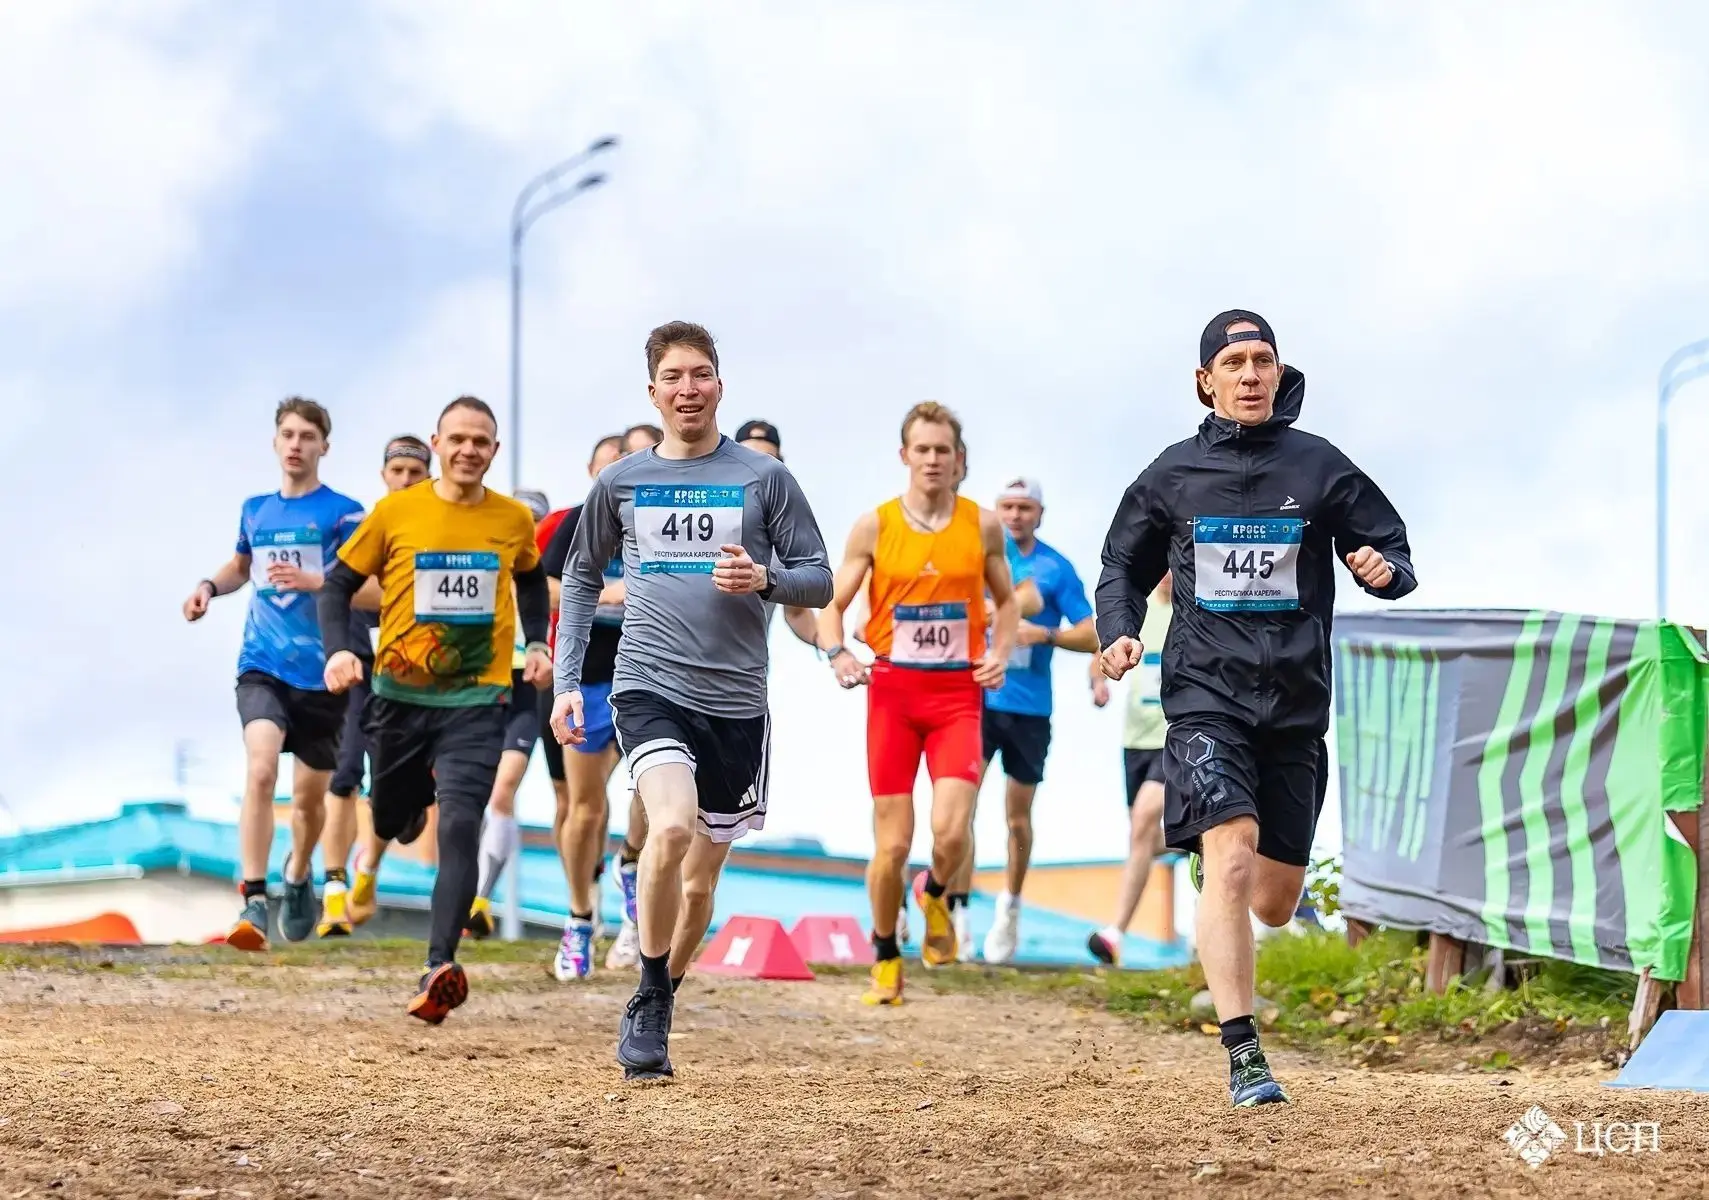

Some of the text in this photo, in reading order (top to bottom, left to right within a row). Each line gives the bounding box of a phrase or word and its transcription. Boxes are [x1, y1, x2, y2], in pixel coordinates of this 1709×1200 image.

[674, 490, 708, 499] КРОСС
[661, 512, 714, 542] 419
[1232, 524, 1266, 534] КРОСС
[1222, 550, 1275, 580] 445
[437, 575, 479, 598] 448
[1214, 589, 1282, 597] РЕСПУБЛИКА КАРЕЛИЯ
[913, 624, 950, 650] 440
